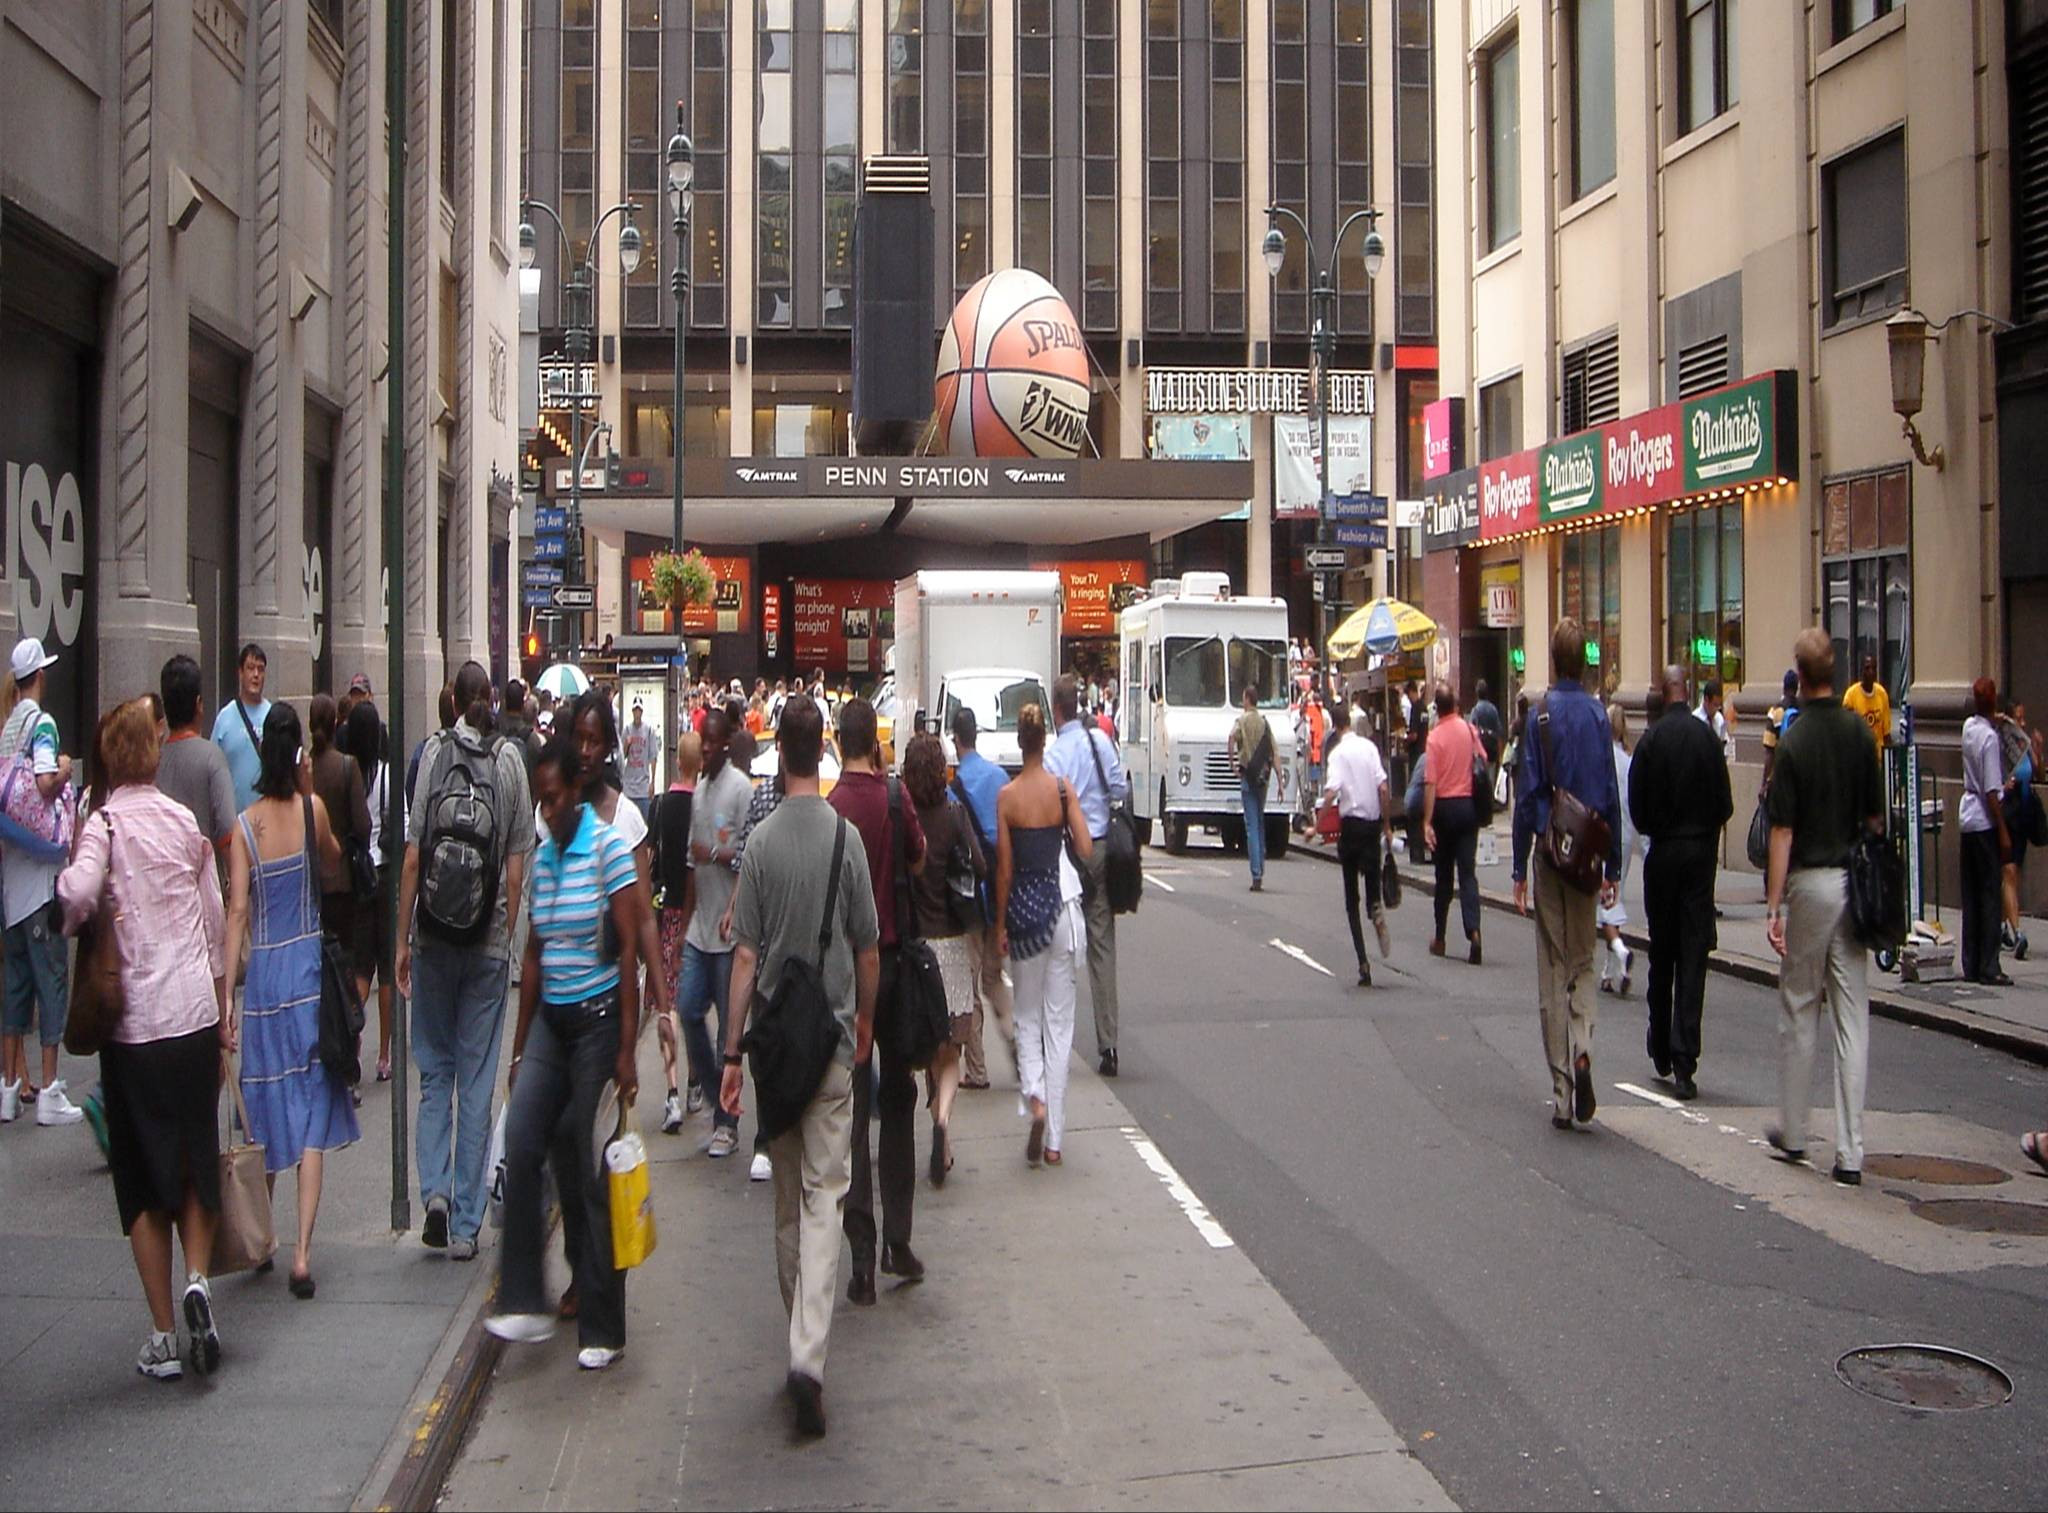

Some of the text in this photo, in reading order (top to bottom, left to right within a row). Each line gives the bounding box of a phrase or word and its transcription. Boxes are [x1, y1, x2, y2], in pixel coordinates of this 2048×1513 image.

[1149, 372, 1230, 412] MADISON
[1236, 373, 1302, 412] SQUARE
[1691, 395, 1760, 460] Nathan's
[1608, 429, 1673, 488] Roy Rogers
[752, 471, 797, 482] AMTRAK
[826, 467, 989, 487] PENN STATION
[1021, 471, 1066, 482] AMTRAK
[1545, 444, 1594, 496] Nathan's
[1484, 475, 1500, 519] Roy
[1500, 470, 1532, 521] Rogers
[1337, 501, 1385, 514] Seventh Ave
[1434, 495, 1467, 536] Lindy's
[547, 515, 562, 527] Ave
[1337, 528, 1385, 544] Fashion Ave
[546, 541, 562, 554] Ave
[1070, 573, 1099, 585] Your TV
[795, 583, 823, 597] What's
[1078, 588, 1106, 601] ringing.
[795, 601, 836, 617] on phone
[795, 619, 830, 636] tonight?
